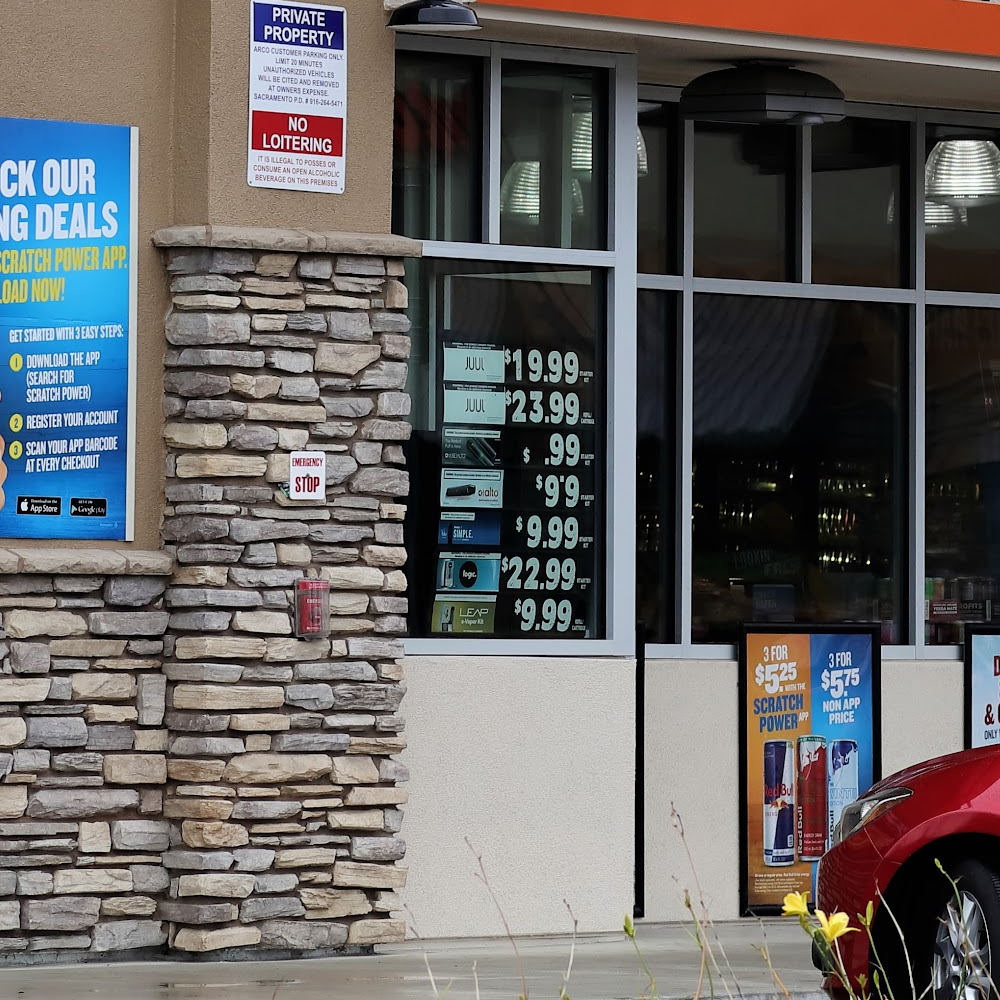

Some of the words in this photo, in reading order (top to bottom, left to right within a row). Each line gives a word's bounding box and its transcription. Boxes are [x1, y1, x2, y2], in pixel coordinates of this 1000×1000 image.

[273, 7, 325, 27] PRIVATE
[264, 25, 334, 47] PROPERTY
[271, 48, 301, 56] CUSTOMER
[304, 51, 327, 59] PARKING
[264, 66, 306, 76] UNAUTHORIZED
[308, 70, 334, 79] VEHICLES
[299, 60, 322, 68] MINUTES
[277, 86, 301, 94] OWNERS
[313, 80, 339, 88] REMOVED
[254, 93, 292, 103] SACRAMENTO
[289, 117, 307, 132] NO
[263, 133, 332, 153] LOITERING
[272, 157, 294, 165] ILLEGAL
[305, 160, 326, 168] POSSES
[43, 159, 96, 196] OUR
[254, 165, 281, 173] CONSUME
[309, 170, 339, 178] ALCOHOLIC
[255, 174, 286, 183] BEVERAGE
[311, 178, 337, 187] PREMISES
[35, 201, 118, 240] DEALS
[0, 248, 51, 274] CRATCH
[55, 247, 99, 272] POWER
[102, 246, 128, 270] APP.
[0, 279, 28, 304] OAD
[32, 278, 65, 303] NOW!
[9, 329, 22, 343] GET
[24, 328, 54, 342] STARTED
[56, 327, 74, 340] WITH
[75, 327, 80, 339] 3
[81, 326, 99, 339] EASY
[100, 324, 123, 338] STEPS:
[27, 353, 68, 368] DOWNLOAD
[70, 352, 84, 366] THE
[86, 351, 100, 365] APP
[465, 356, 484, 371] JUUL
[504, 348, 579, 385] $19.99
[26, 371, 58, 388] (SEARCH
[60, 369, 74, 384] FOR
[27, 388, 60, 403] SCRATCH
[62, 384, 91, 401] POWER)
[465, 398, 485, 413] JUUL
[505, 389, 580, 425] $23.99
[27, 413, 62, 429] REGISTER
[64, 412, 83, 427] YOUR
[85, 410, 118, 425] ACCOUNT
[26, 441, 46, 456] SCAN
[48, 439, 68, 454] YOUR
[69, 438, 83, 453] APP
[85, 436, 118, 452] BARCODE
[26, 458, 35, 473] AT
[37, 457, 60, 472] EVERY
[62, 454, 100, 470] CHECKOUT
[292, 458, 323, 467] EMERGENCY
[296, 476, 320, 492] STOP
[485, 487, 498, 497] alto
[30, 504, 42, 513] App
[516, 515, 578, 549] $9.99
[502, 556, 576, 591] $22.99
[460, 607, 488, 617] LEAP
[515, 598, 572, 632] $9.99
[764, 646, 769, 662] 3
[771, 645, 788, 661] FOR
[829, 653, 835, 668] 3
[836, 651, 852, 667] FOR
[754, 694, 803, 715] SCRATCH
[823, 699, 842, 712] NON
[843, 697, 860, 710] APP
[760, 713, 797, 733] POWER
[799, 711, 808, 721] APP
[829, 711, 854, 725] PRICE
[985, 704, 994, 725] &
[984, 730, 997, 740] ONLY
